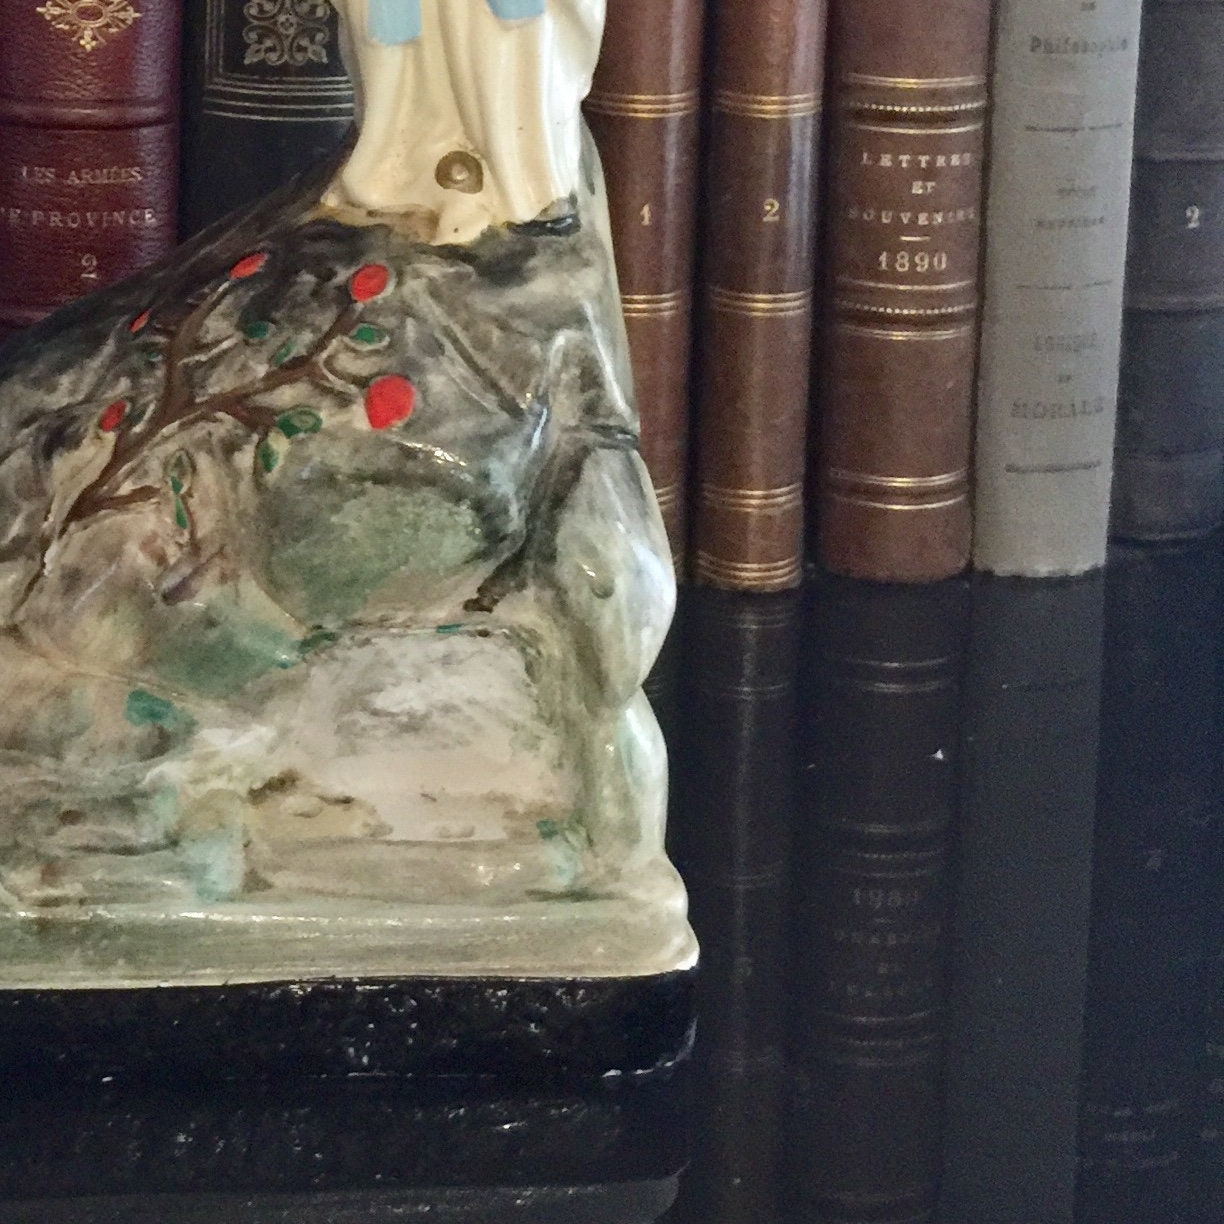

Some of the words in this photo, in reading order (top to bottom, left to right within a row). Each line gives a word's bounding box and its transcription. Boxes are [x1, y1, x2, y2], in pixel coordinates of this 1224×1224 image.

[861, 152, 973, 168] LETTRES
[911, 180, 936, 195] ET
[32, 208, 157, 228] PROVINCE
[640, 203, 652, 226] 1
[763, 198, 780, 223] 2
[1185, 205, 1201, 229] 2
[81, 253, 99, 279] 2
[878, 250, 948, 273] 1890
